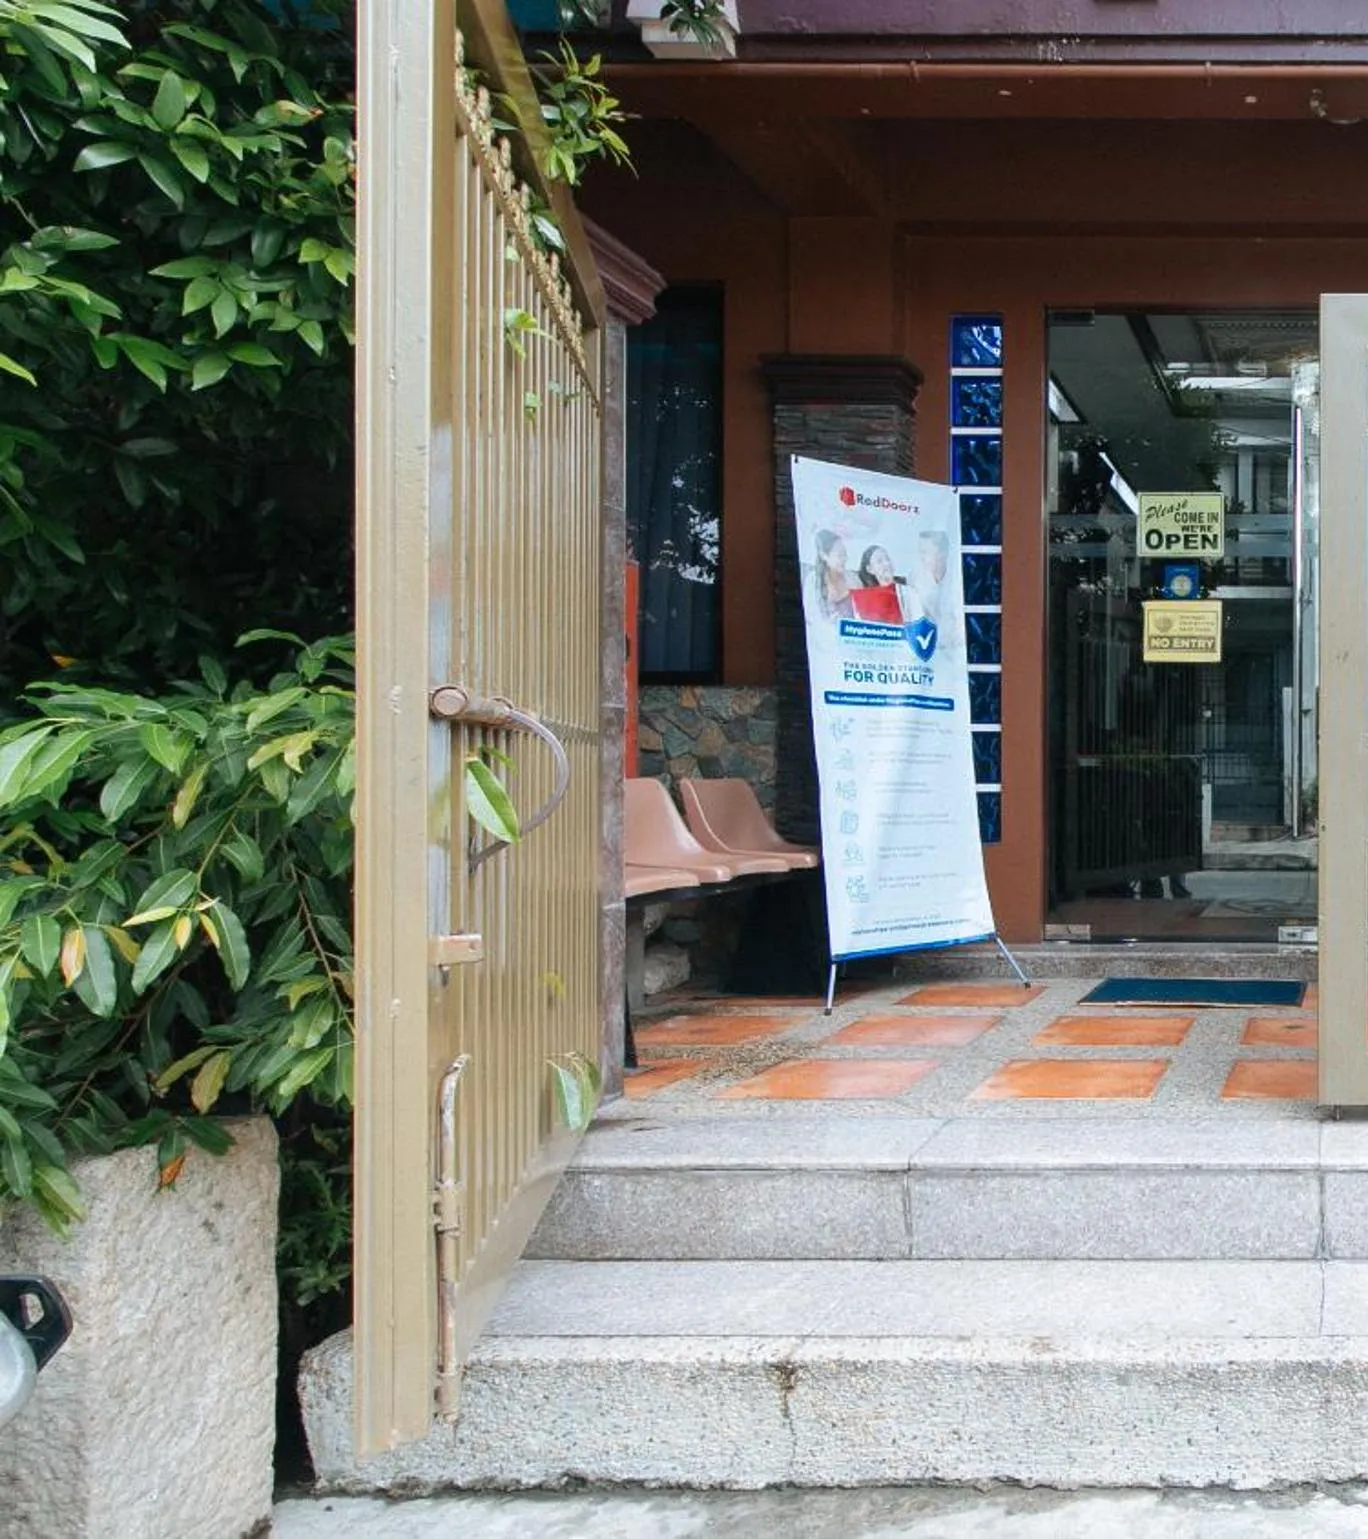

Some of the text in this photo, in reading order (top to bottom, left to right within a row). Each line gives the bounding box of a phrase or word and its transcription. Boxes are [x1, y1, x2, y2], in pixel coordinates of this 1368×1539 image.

[1145, 499, 1188, 522] Please
[1174, 511, 1219, 523] COME IN
[1145, 529, 1218, 549] OPEN
[1150, 637, 1214, 649] NO ENTRY
[844, 670, 934, 686] FOR QUALITY
